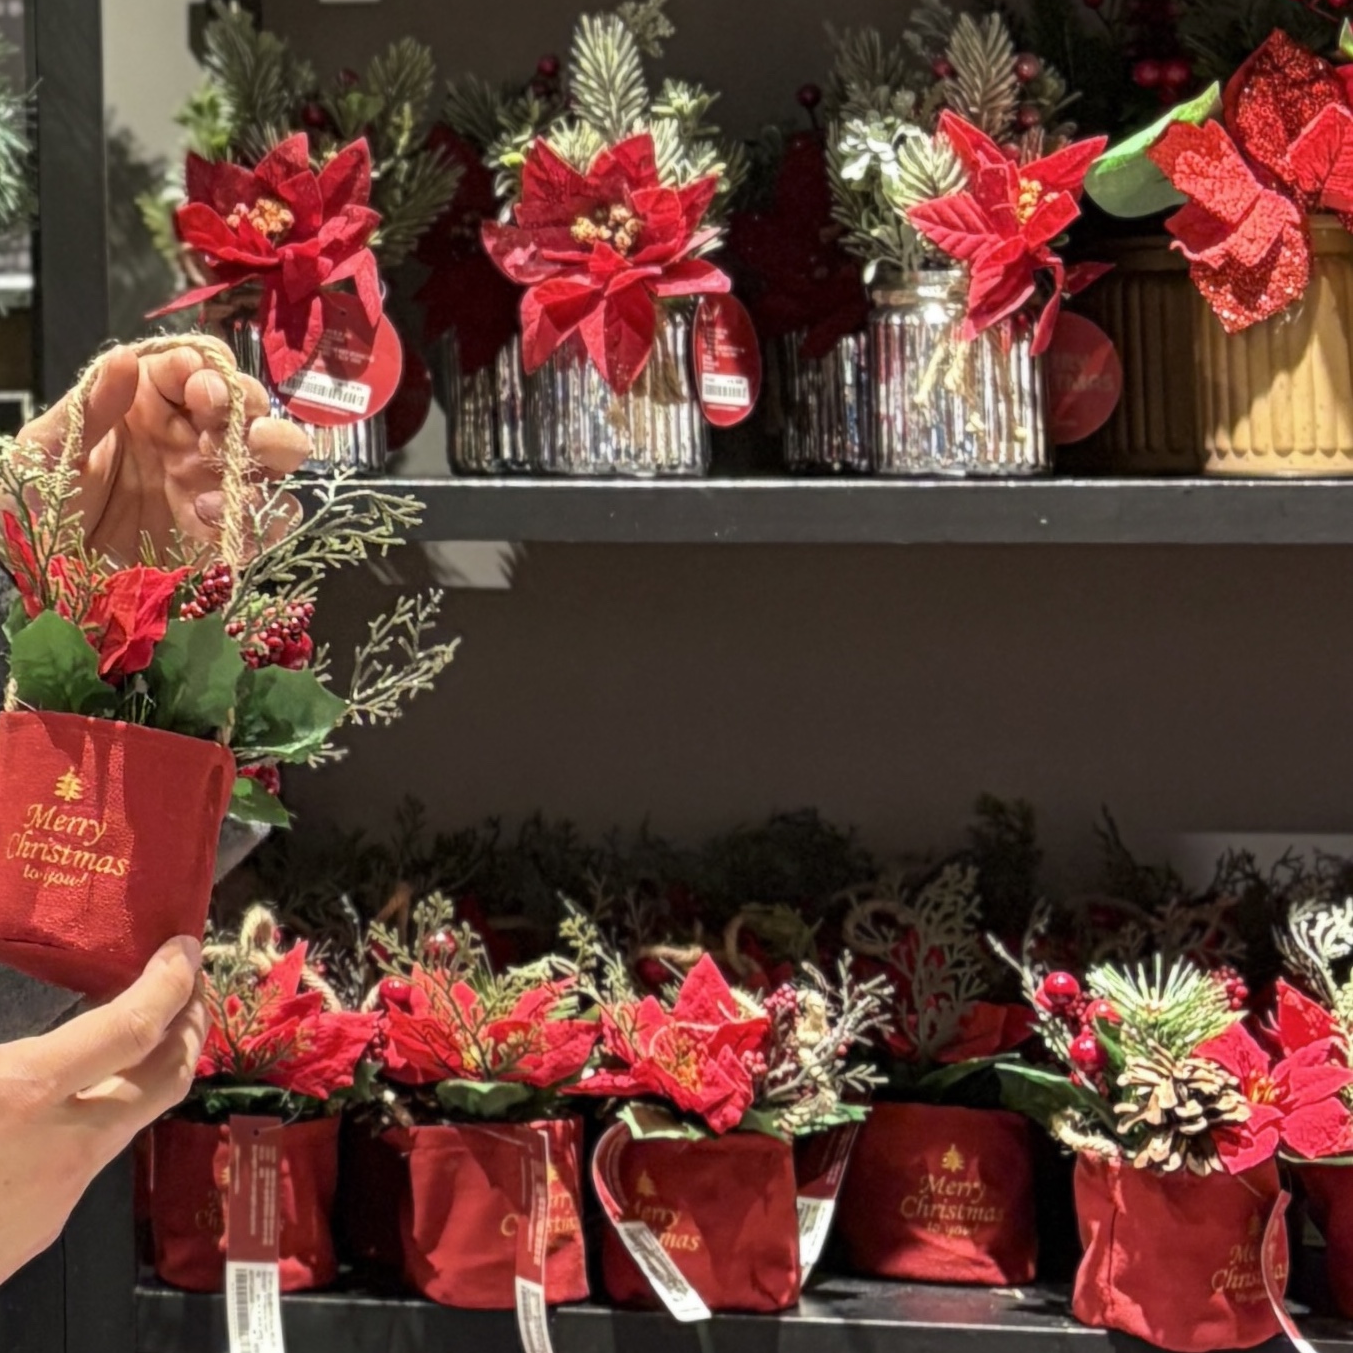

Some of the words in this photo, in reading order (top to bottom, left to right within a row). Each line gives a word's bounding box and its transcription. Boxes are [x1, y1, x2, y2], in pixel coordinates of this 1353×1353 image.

[23, 803, 107, 847] Merry
[6, 829, 130, 876] Christmas
[900, 1194, 1004, 1222] Christmas
[919, 1173, 987, 1205] Merry
